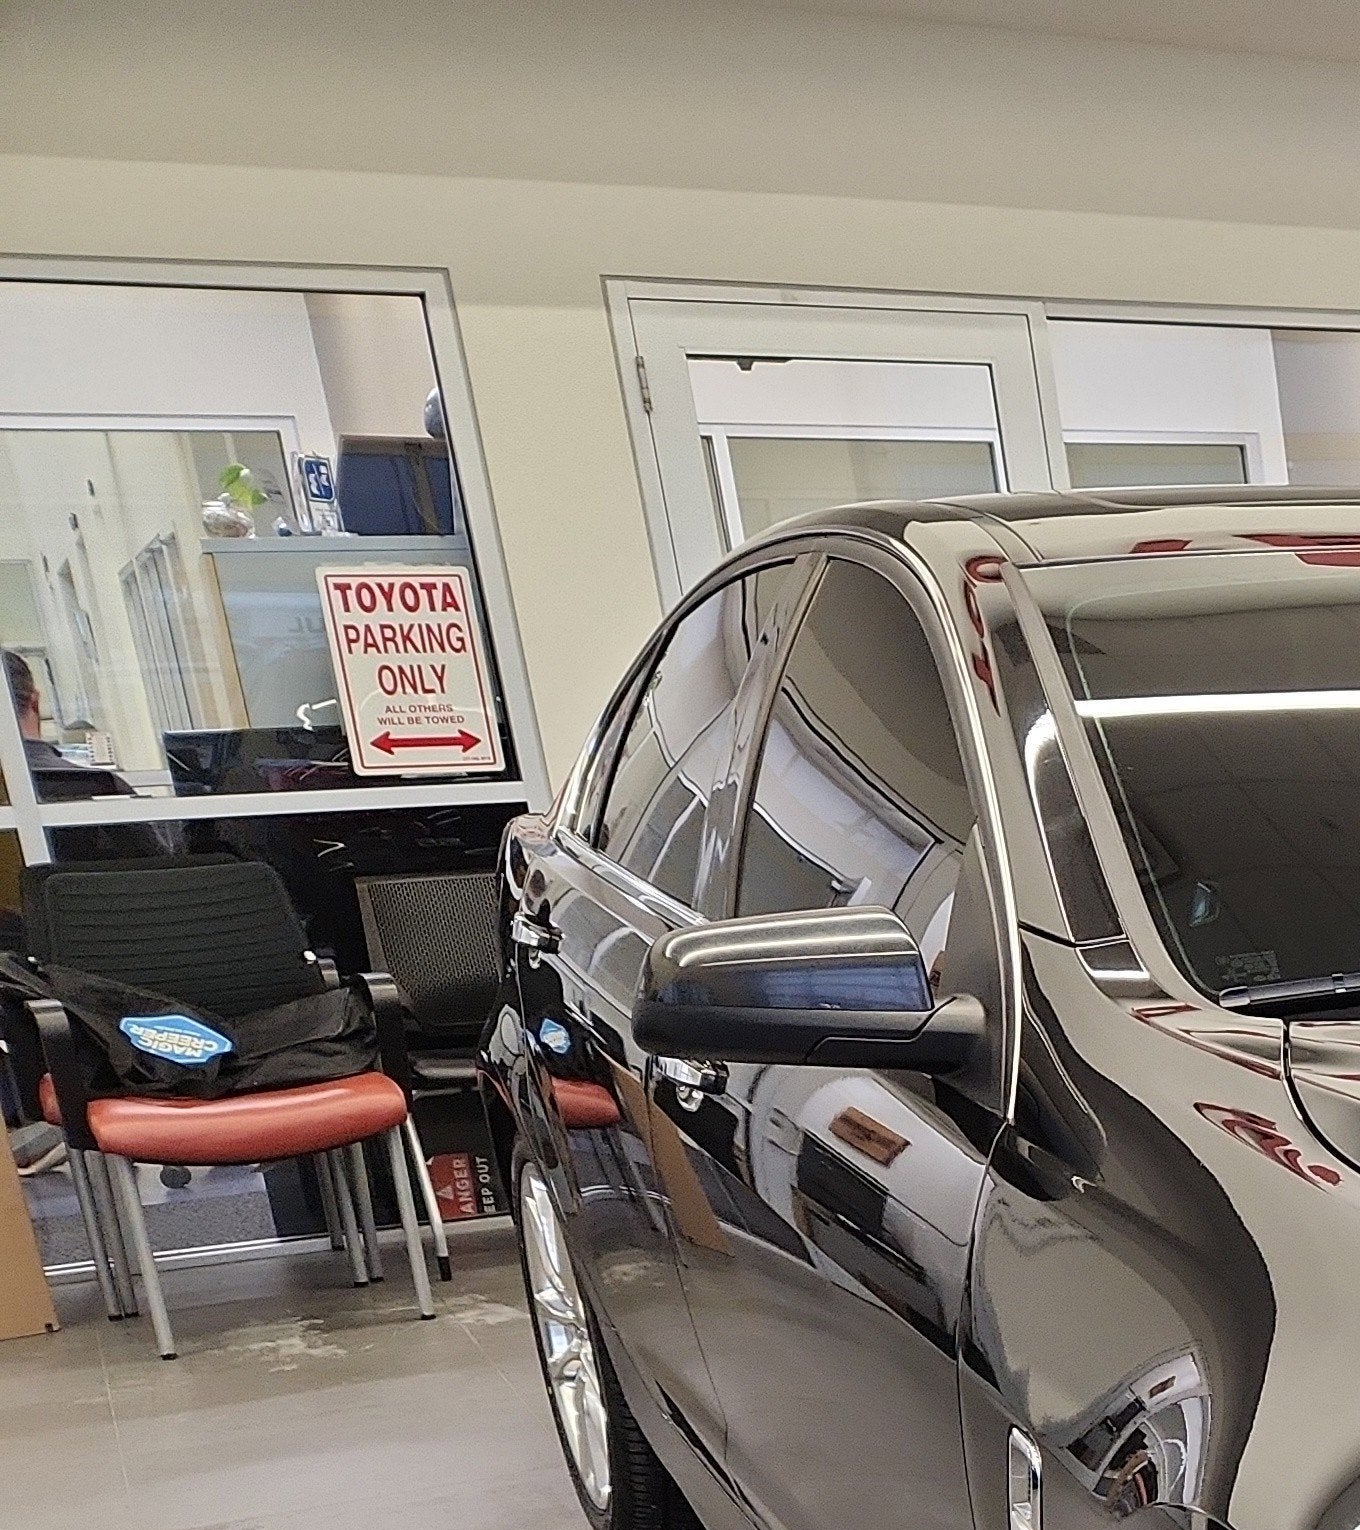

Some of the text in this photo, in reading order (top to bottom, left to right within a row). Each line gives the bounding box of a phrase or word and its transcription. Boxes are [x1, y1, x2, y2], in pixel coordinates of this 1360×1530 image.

[333, 581, 461, 613] TOYOTA
[343, 622, 467, 655] PARKING
[377, 664, 446, 696] ONLY
[377, 715, 465, 726] WILL BE TOWED
[385, 704, 454, 714] ALL OTHERS
[126, 1023, 219, 1052] CREEPER
[137, 1035, 204, 1058] MAGIC
[452, 1159, 476, 1214] ANGER
[475, 1156, 497, 1214] EEP OUT
